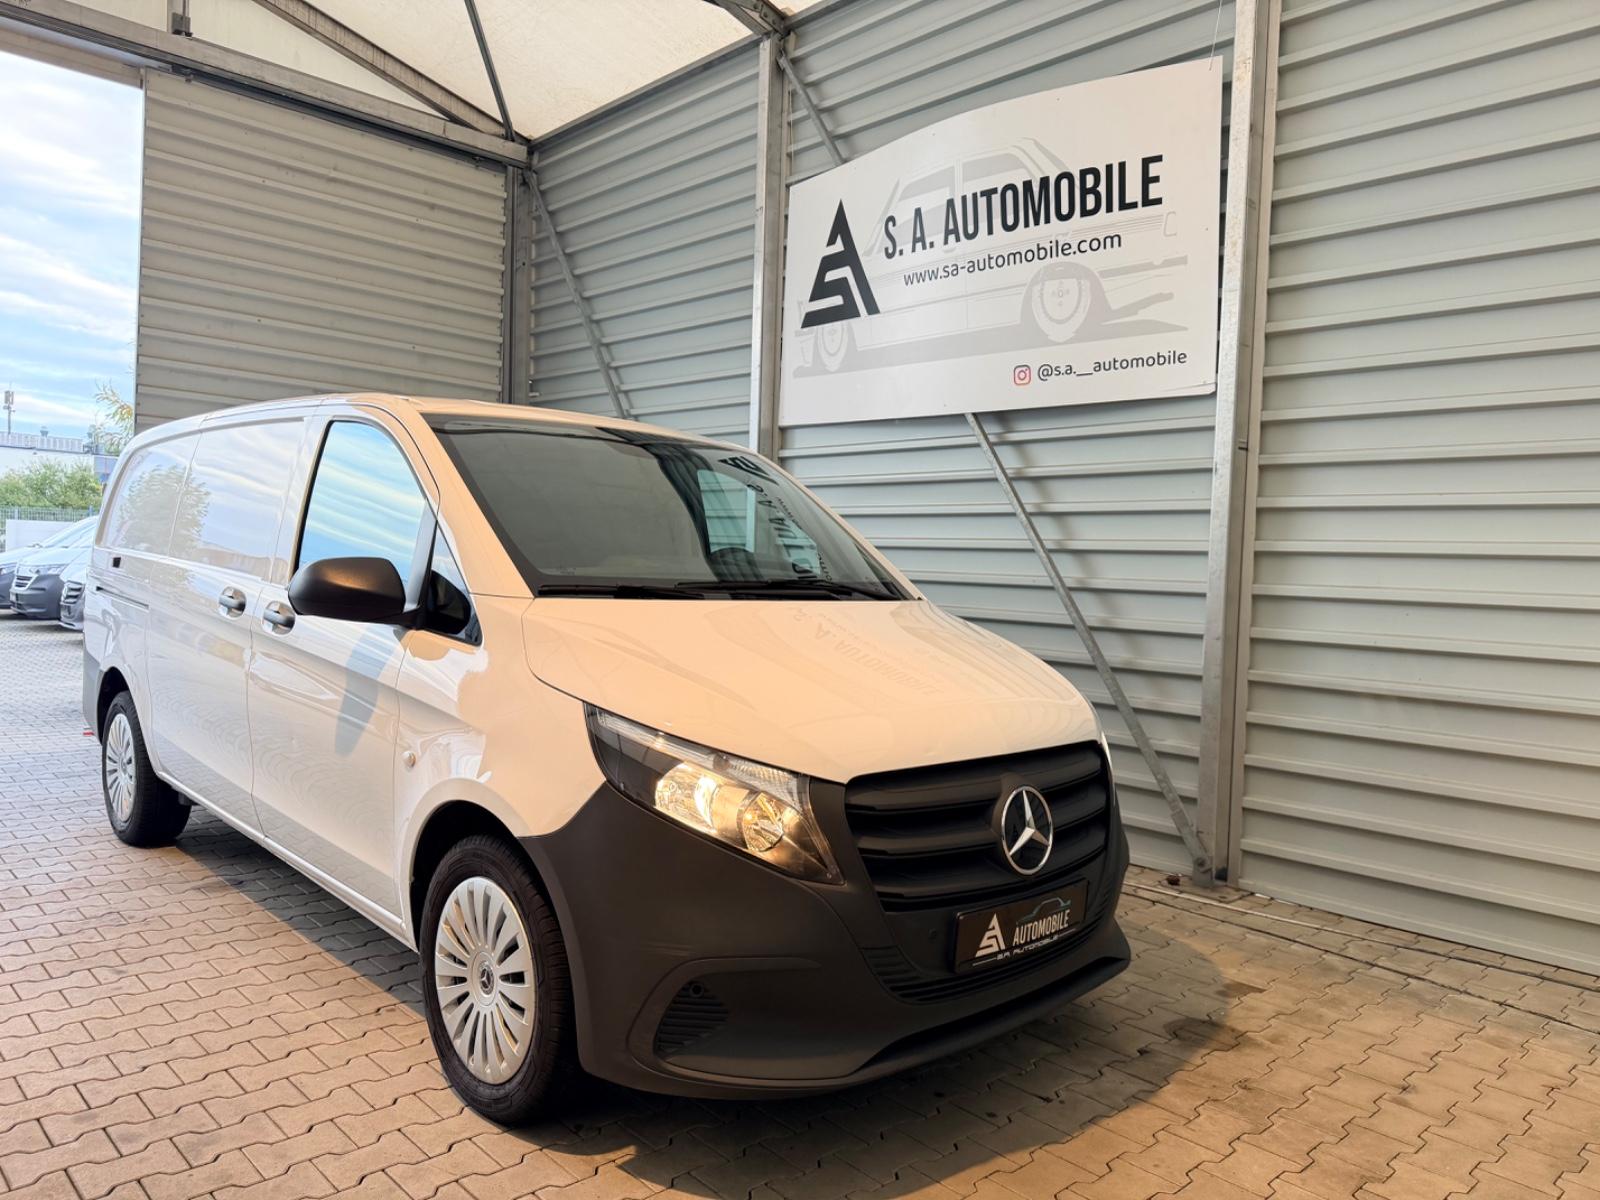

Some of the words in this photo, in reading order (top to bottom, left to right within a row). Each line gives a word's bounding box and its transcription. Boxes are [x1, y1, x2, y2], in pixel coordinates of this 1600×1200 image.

[884, 214, 904, 260] S.
[911, 206, 935, 253] A.
[943, 154, 1164, 246] AUTOMOBILE
[903, 233, 1122, 287] www.sa-automobile.com
[1012, 908, 1071, 947] AUTOMOBILE
